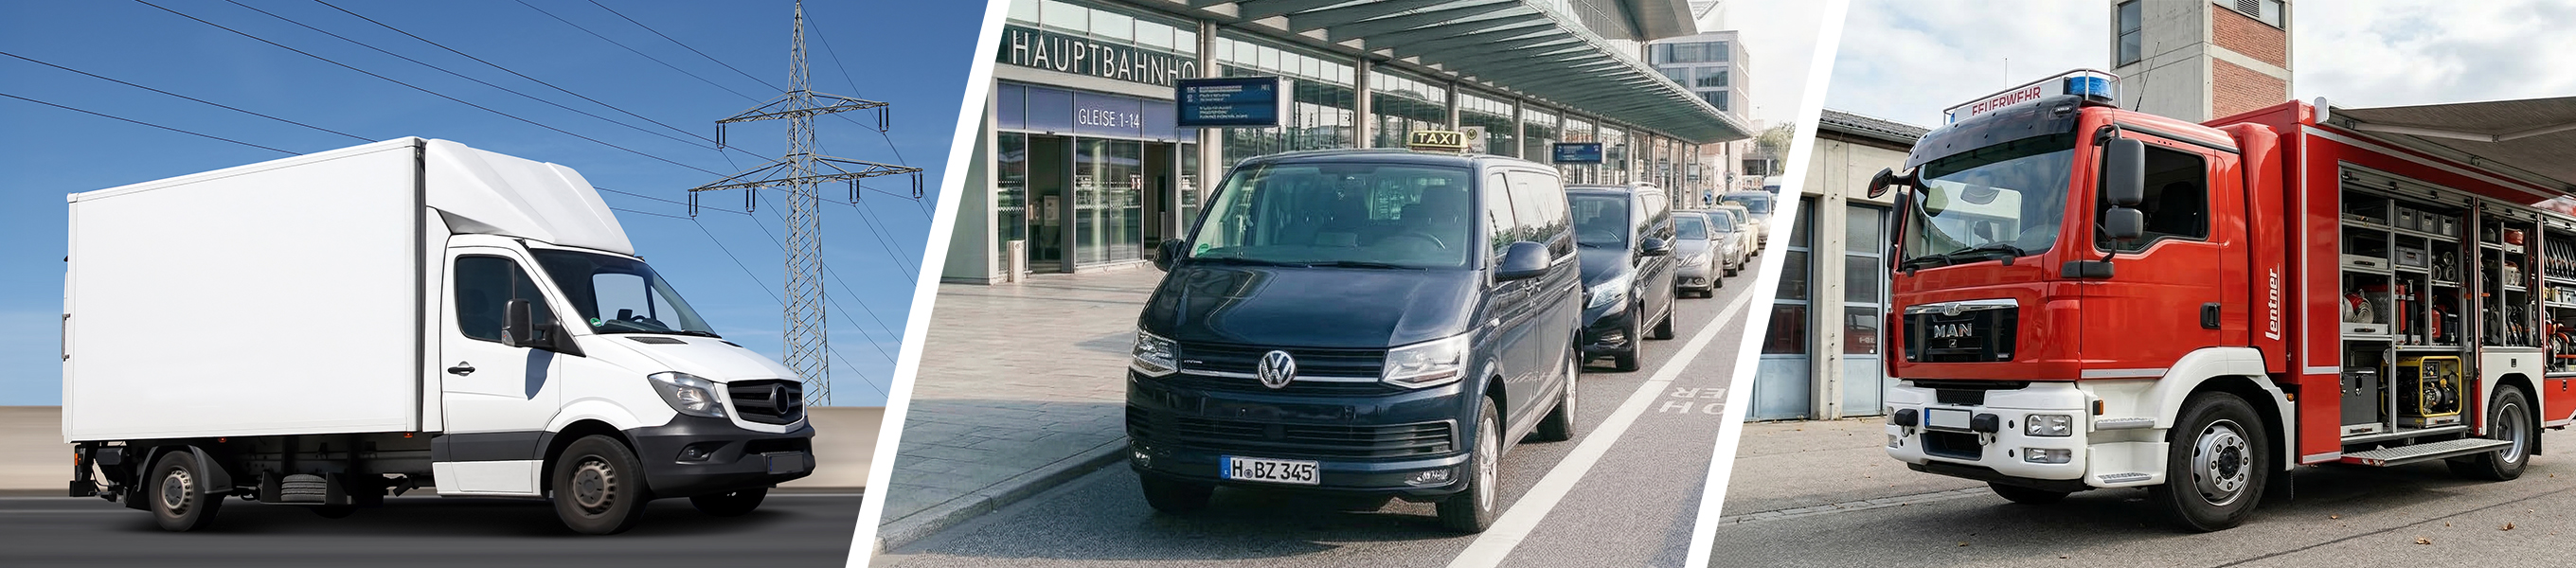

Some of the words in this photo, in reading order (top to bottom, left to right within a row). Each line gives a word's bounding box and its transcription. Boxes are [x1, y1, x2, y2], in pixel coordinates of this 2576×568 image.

[1079, 108, 1116, 127] GLEISE
[1119, 112, 1140, 129] 1-14
[1418, 133, 1457, 145] TAXI
[2265, 263, 2281, 341] Lentner
[1934, 323, 1973, 338] MAN
[1259, 350, 1295, 388] VW
[1232, 460, 1243, 477] H
[1255, 461, 1277, 479] BZ
